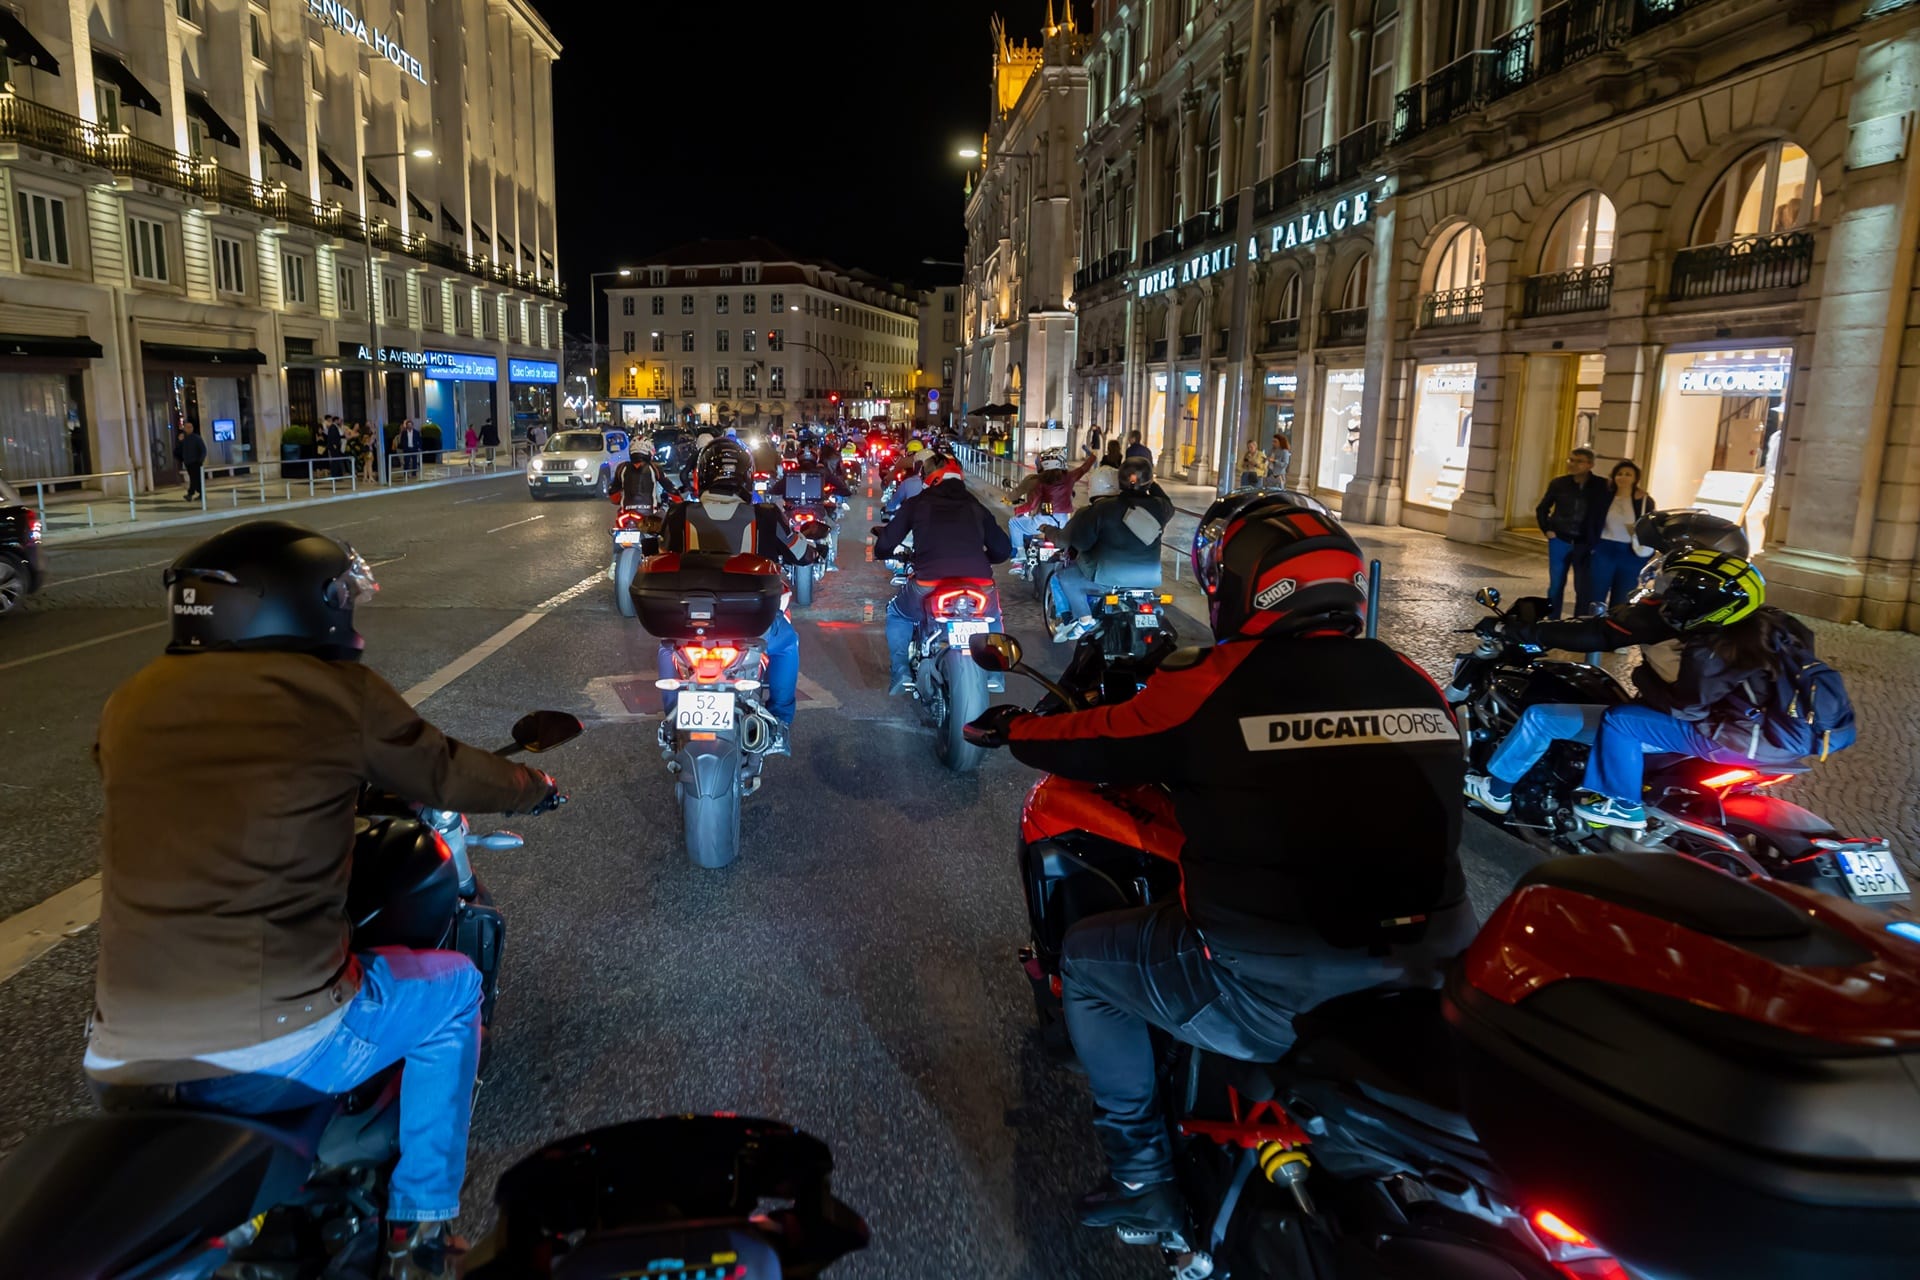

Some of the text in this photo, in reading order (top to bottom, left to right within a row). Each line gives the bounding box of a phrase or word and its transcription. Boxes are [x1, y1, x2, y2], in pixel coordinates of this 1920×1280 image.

[373, 27, 428, 86] HOTEL
[1138, 191, 1370, 298] HOTEL AVENIA PALACE
[358, 345, 457, 366] ALIS AVENIDA HOTEL
[1679, 370, 1784, 391] FALCONERI
[1257, 580, 1293, 607] SHOEI
[174, 604, 214, 616] SHARK
[696, 694, 716, 710] 52
[1268, 713, 1447, 744] DUCATI CORSE
[1857, 853, 1883, 873] AD
